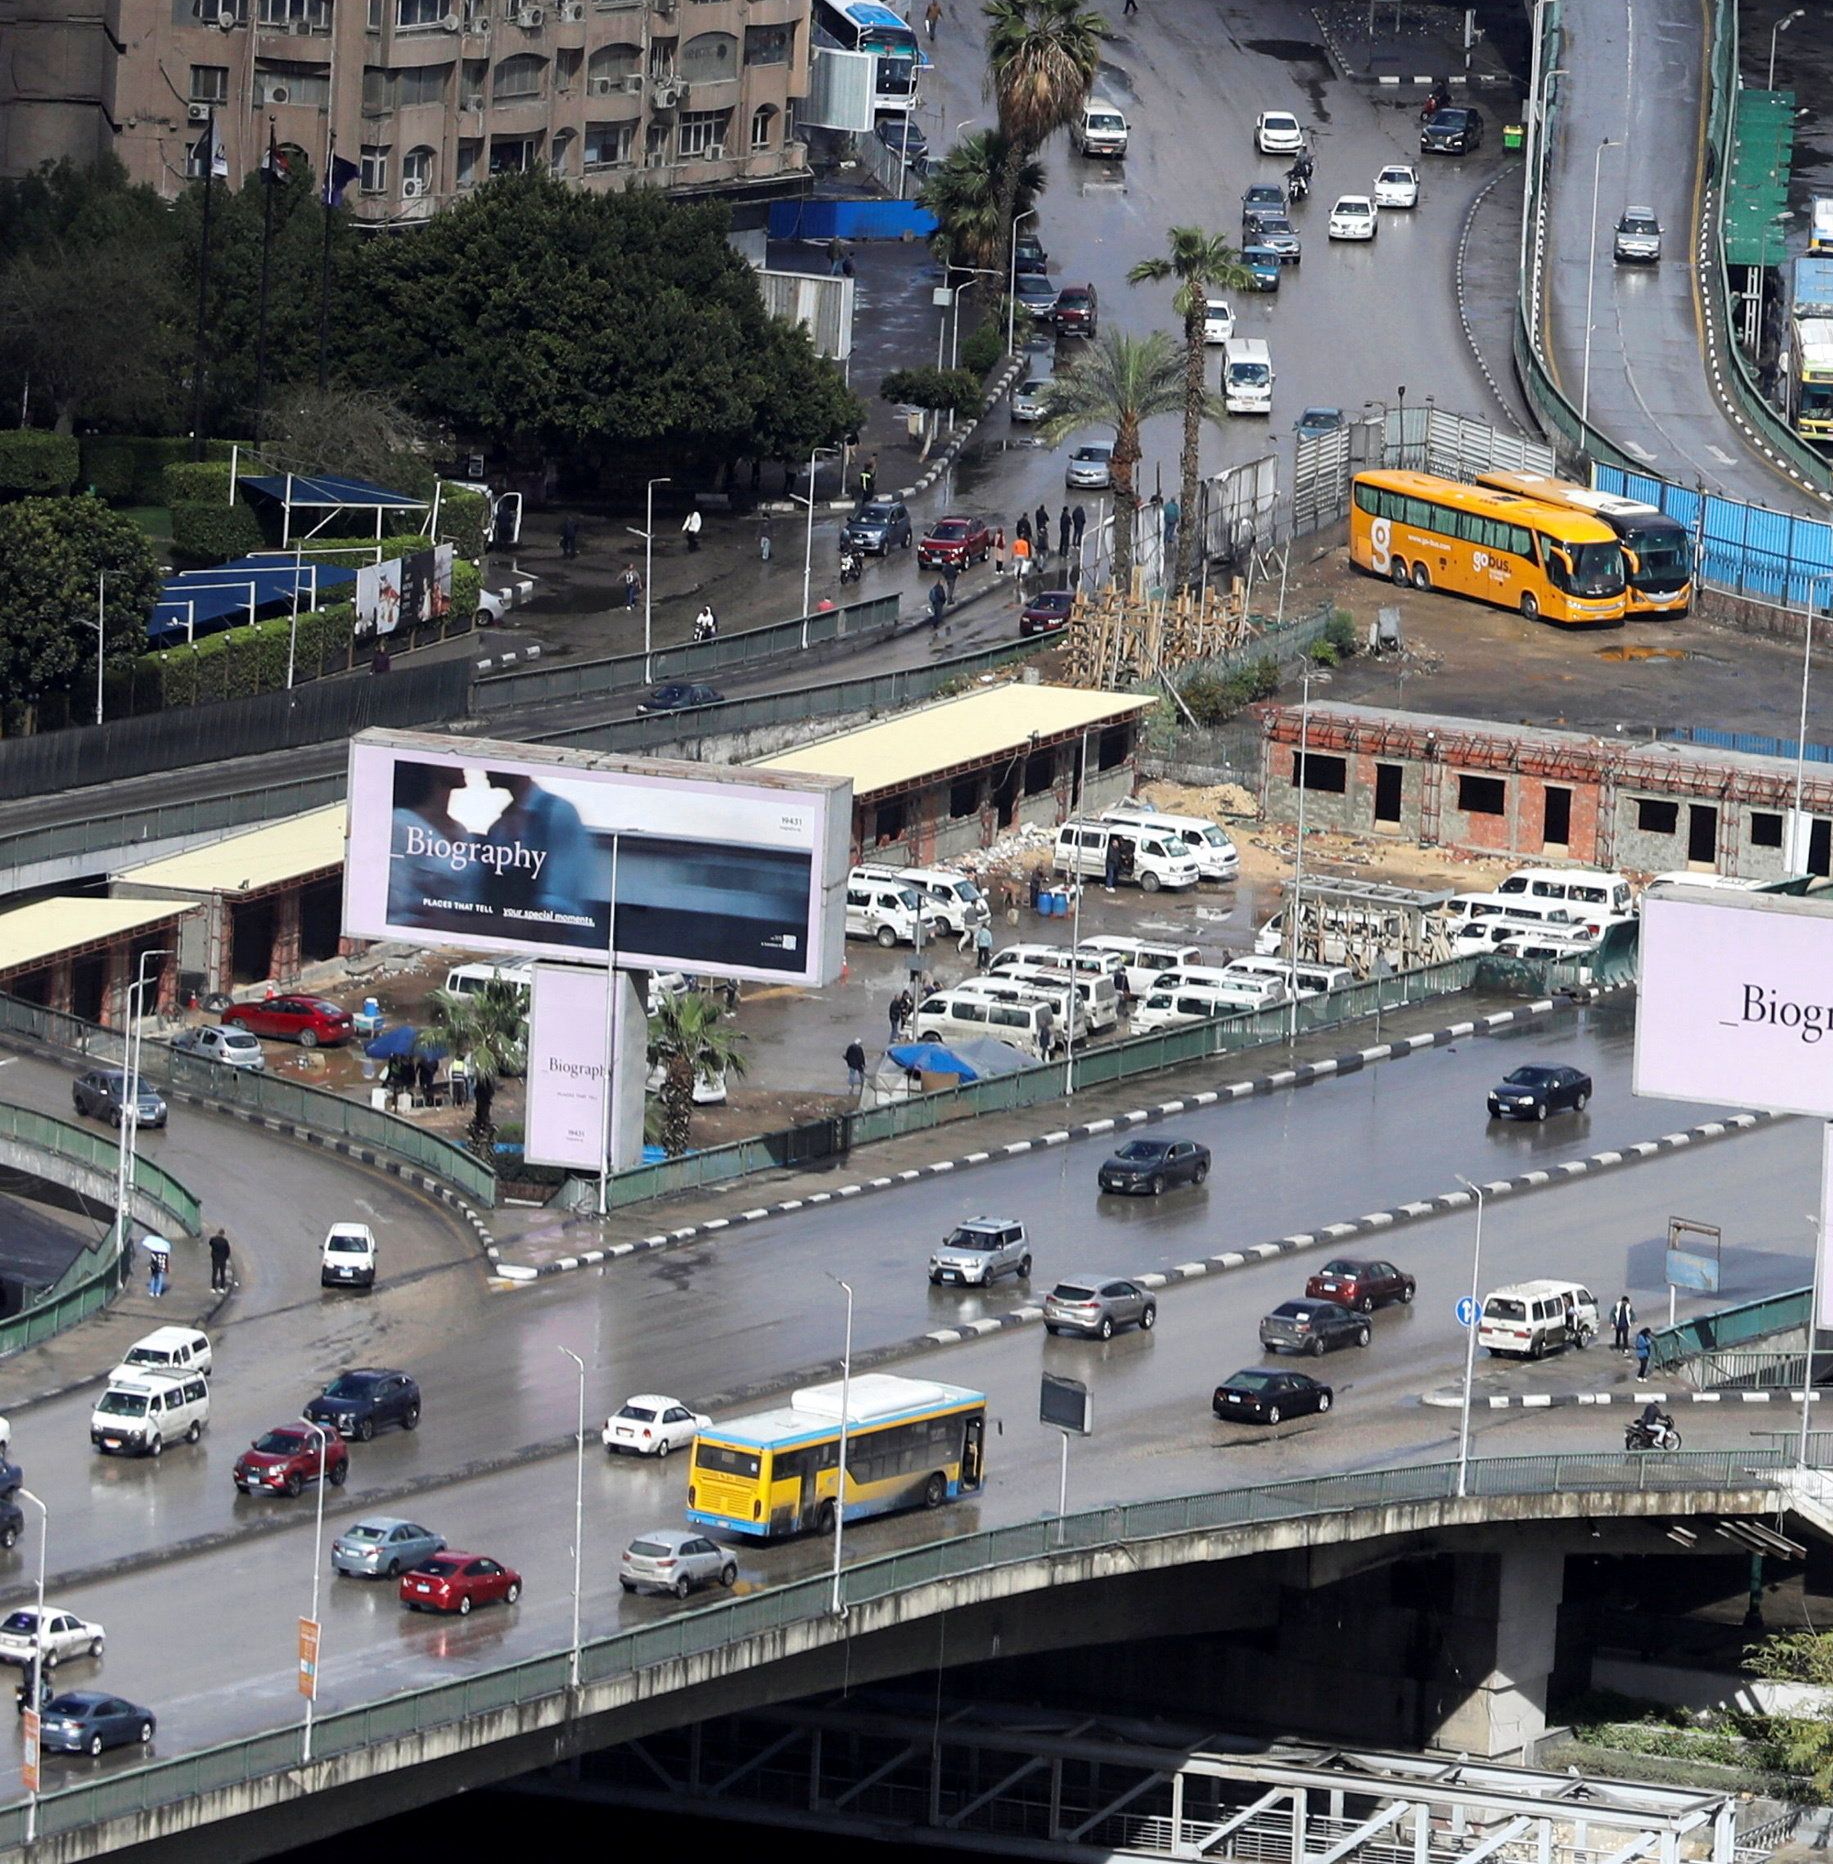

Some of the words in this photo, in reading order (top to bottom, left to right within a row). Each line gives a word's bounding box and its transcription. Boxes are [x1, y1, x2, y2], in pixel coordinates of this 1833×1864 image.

[1407, 534, 1452, 552] www.go-bus.com
[781, 816, 803, 825] 19431
[423, 897, 452, 910] PLACES
[454, 901, 475, 912] THAT
[476, 903, 494, 914] TELL
[503, 906, 523, 920] your
[524, 908, 553, 923] special
[555, 912, 596, 927] moments.
